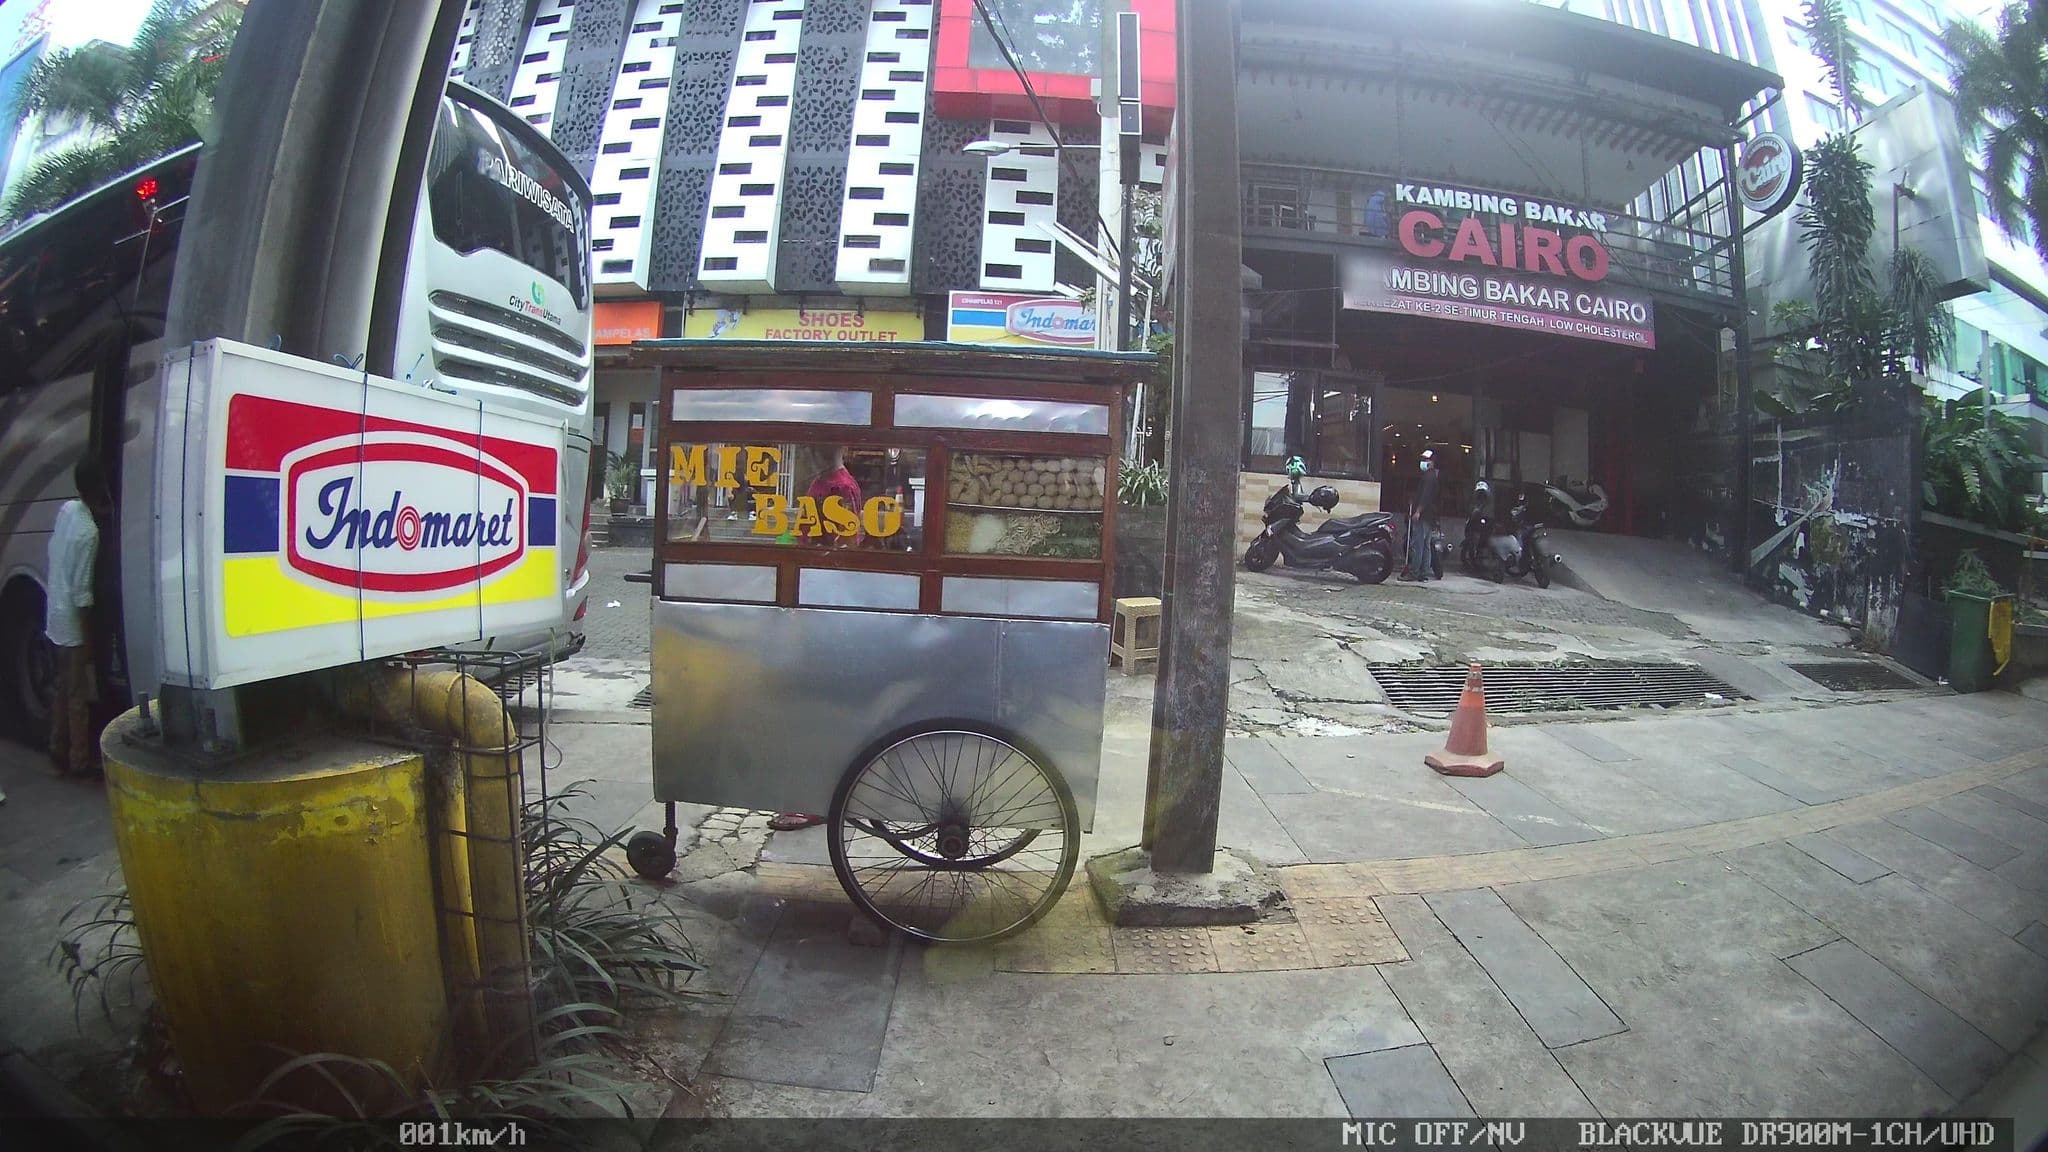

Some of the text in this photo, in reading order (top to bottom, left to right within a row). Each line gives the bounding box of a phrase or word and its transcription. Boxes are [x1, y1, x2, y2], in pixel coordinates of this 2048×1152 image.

[1395, 183, 1607, 233] KAMBING BAKAR
[1398, 210, 1609, 281] CAIRO
[1384, 266, 1647, 324] MBING BAKAR CAIRO
[1415, 301, 1441, 313] KE-2
[1444, 306, 1498, 320] SE-TIMUR
[1550, 318, 1574, 331] LOW
[765, 328, 898, 342] FACTORY OUTLET
[799, 312, 865, 328] SHOES
[1021, 308, 1096, 331] Indomar
[670, 443, 782, 488] MIE
[305, 476, 514, 550] Indomaret
[751, 493, 901, 537] BASO
